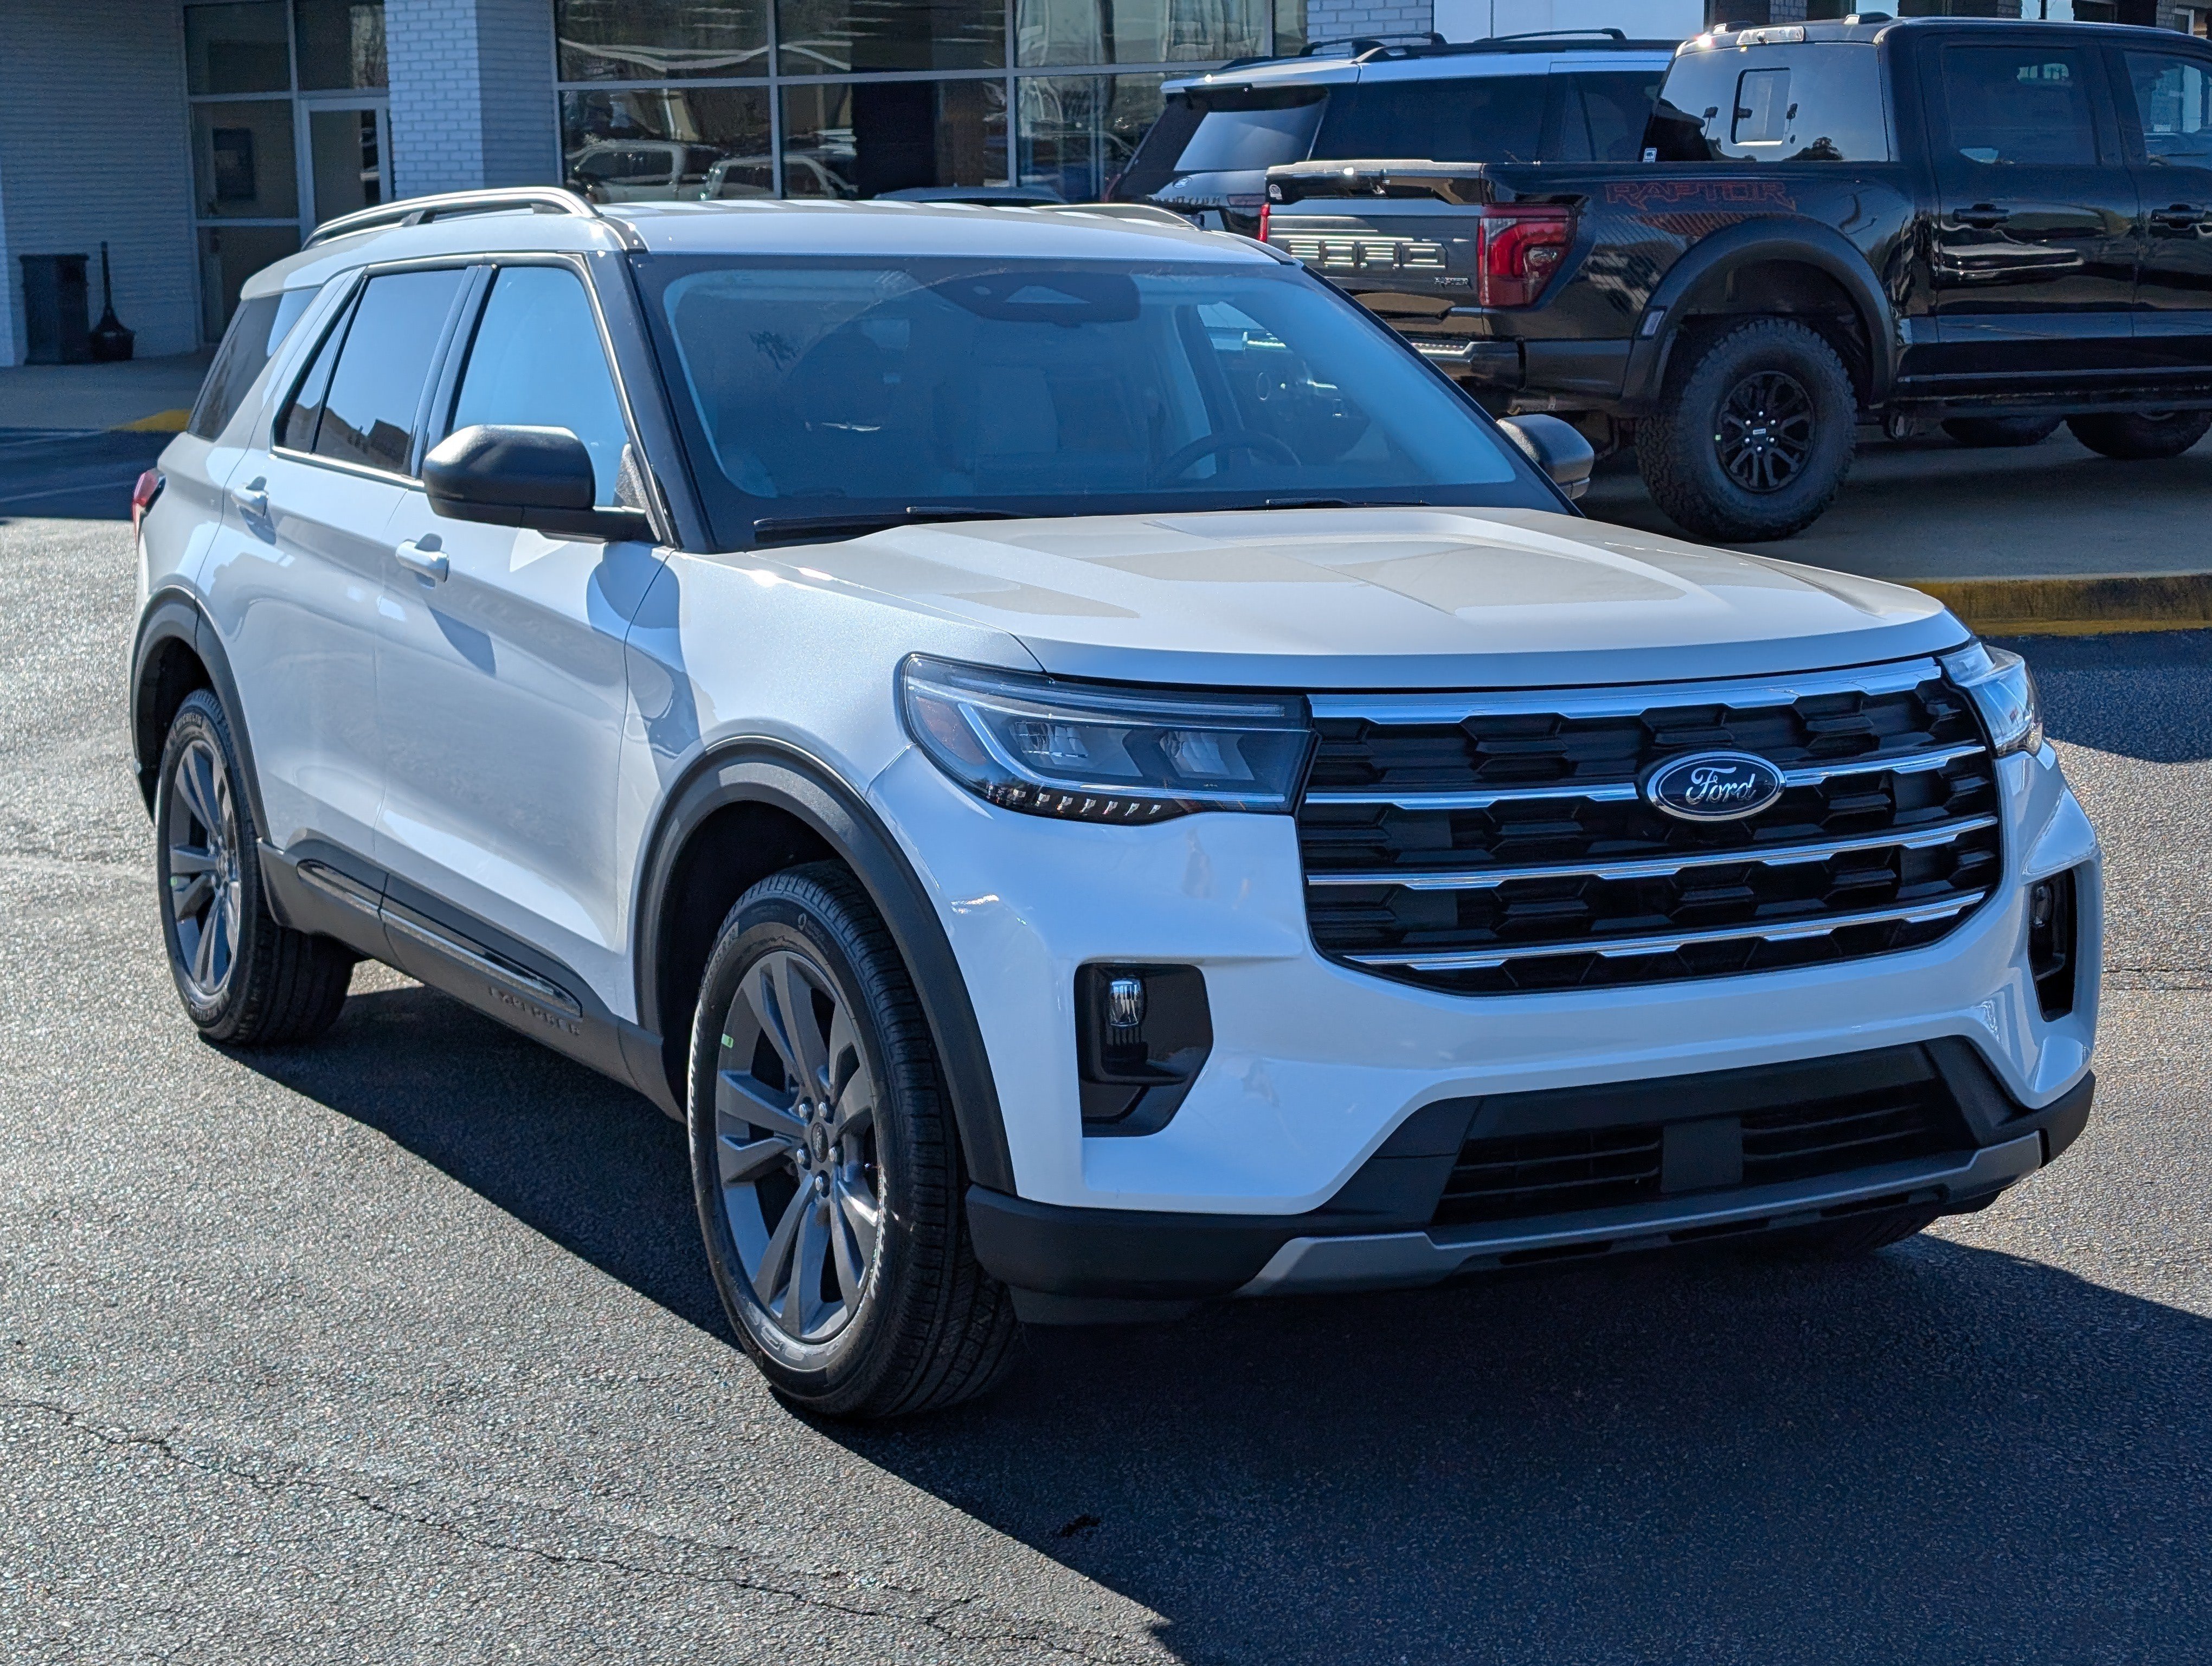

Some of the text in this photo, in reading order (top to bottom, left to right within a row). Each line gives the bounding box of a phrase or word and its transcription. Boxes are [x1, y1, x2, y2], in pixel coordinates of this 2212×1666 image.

[1605, 182, 1796, 212] RAPTOR
[1285, 239, 1447, 270] FORD
[1685, 766, 1757, 805] Ford
